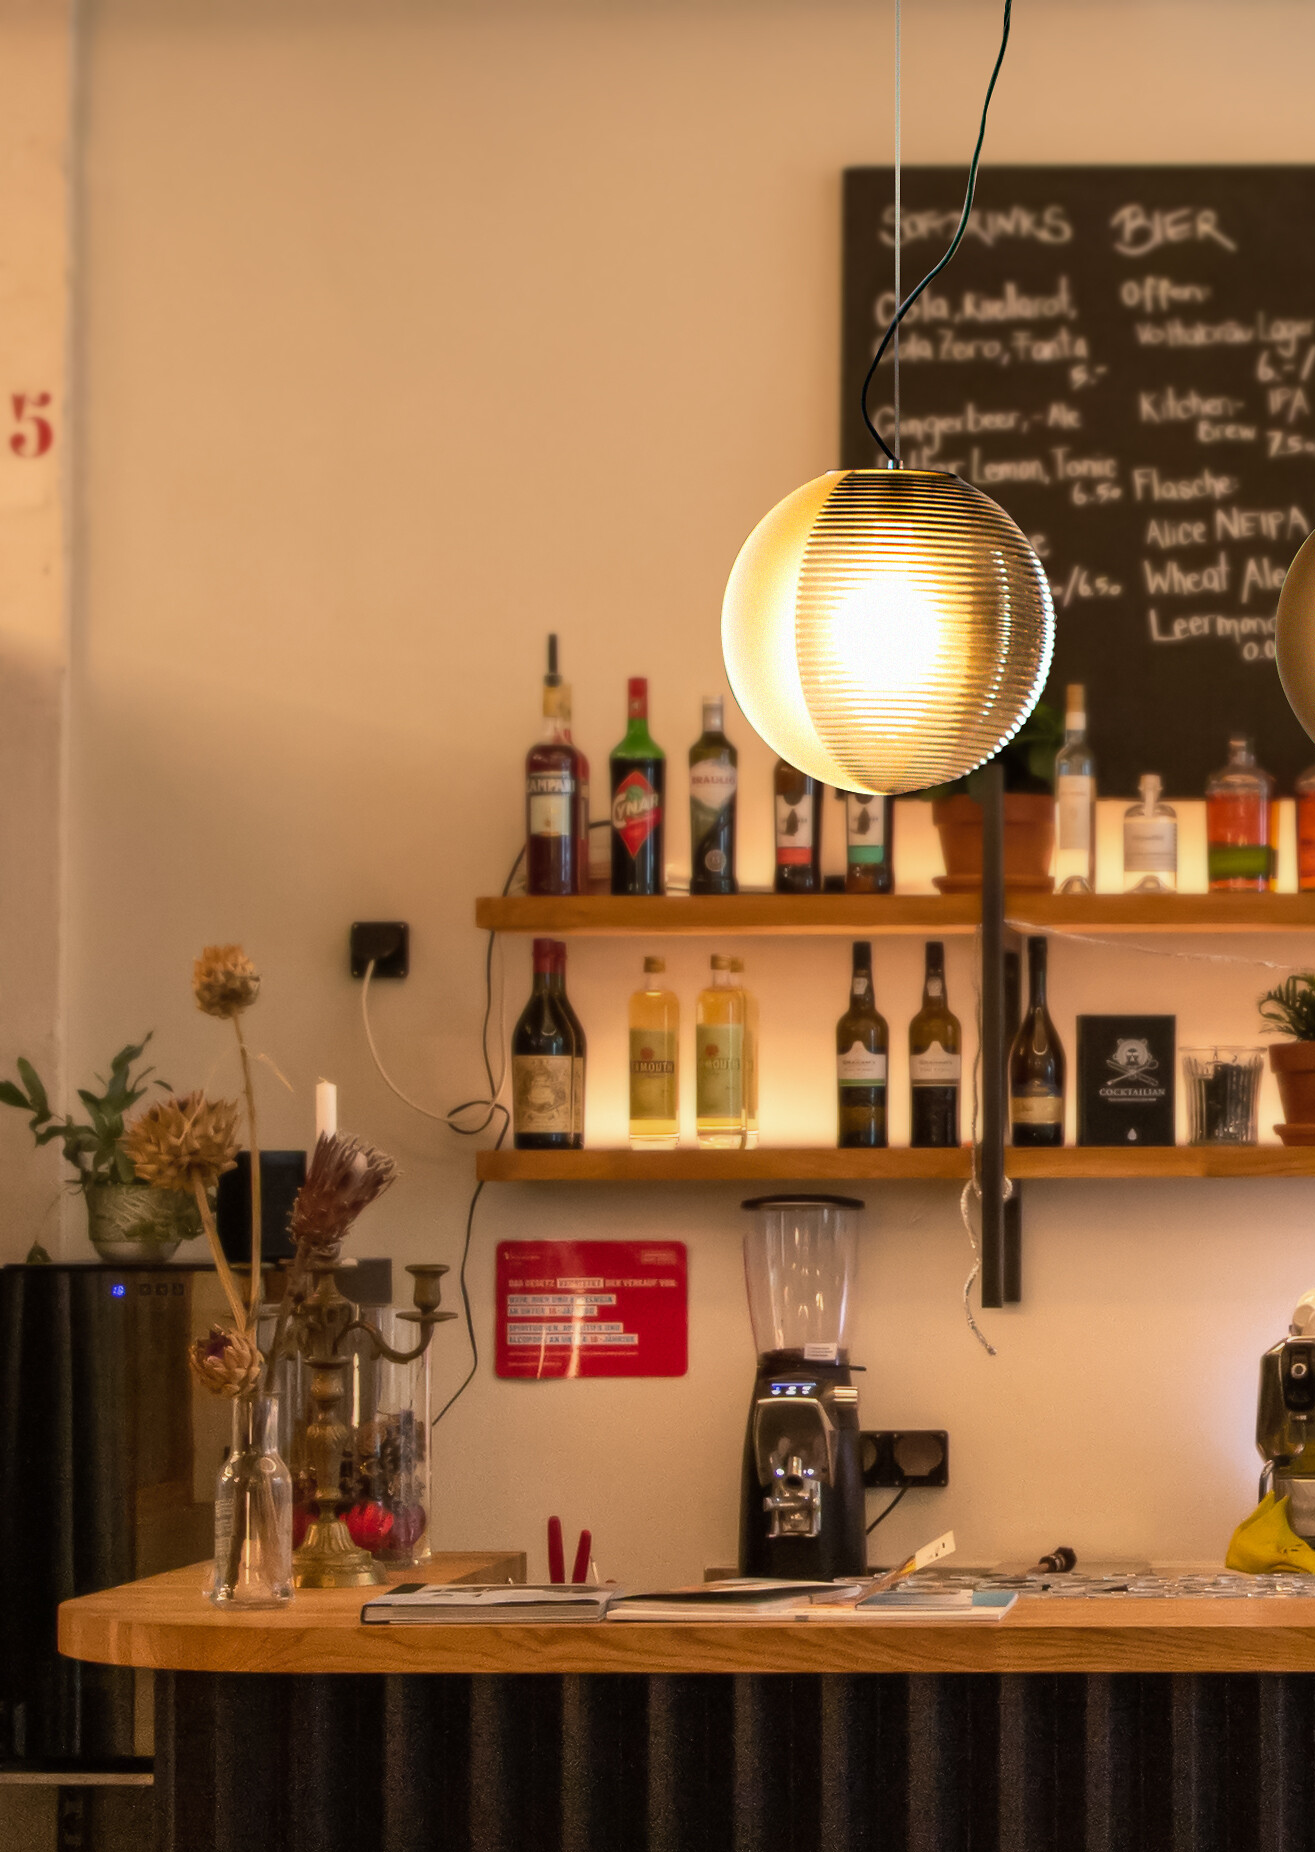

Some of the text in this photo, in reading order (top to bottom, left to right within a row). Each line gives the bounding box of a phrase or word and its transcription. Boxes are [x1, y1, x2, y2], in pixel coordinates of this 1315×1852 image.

[1110, 204, 1237, 257] BIER
[9, 391, 54, 458] 5
[1267, 387, 1311, 424] IPA
[1196, 420, 1257, 444] Brew
[1053, 448, 1118, 480] Tonic
[1147, 517, 1208, 550] Alice
[1214, 505, 1310, 542] NEIPA
[1143, 550, 1289, 605] Wheat Ale
[1099, 1087, 1166, 1096] COCKTAILIAN
